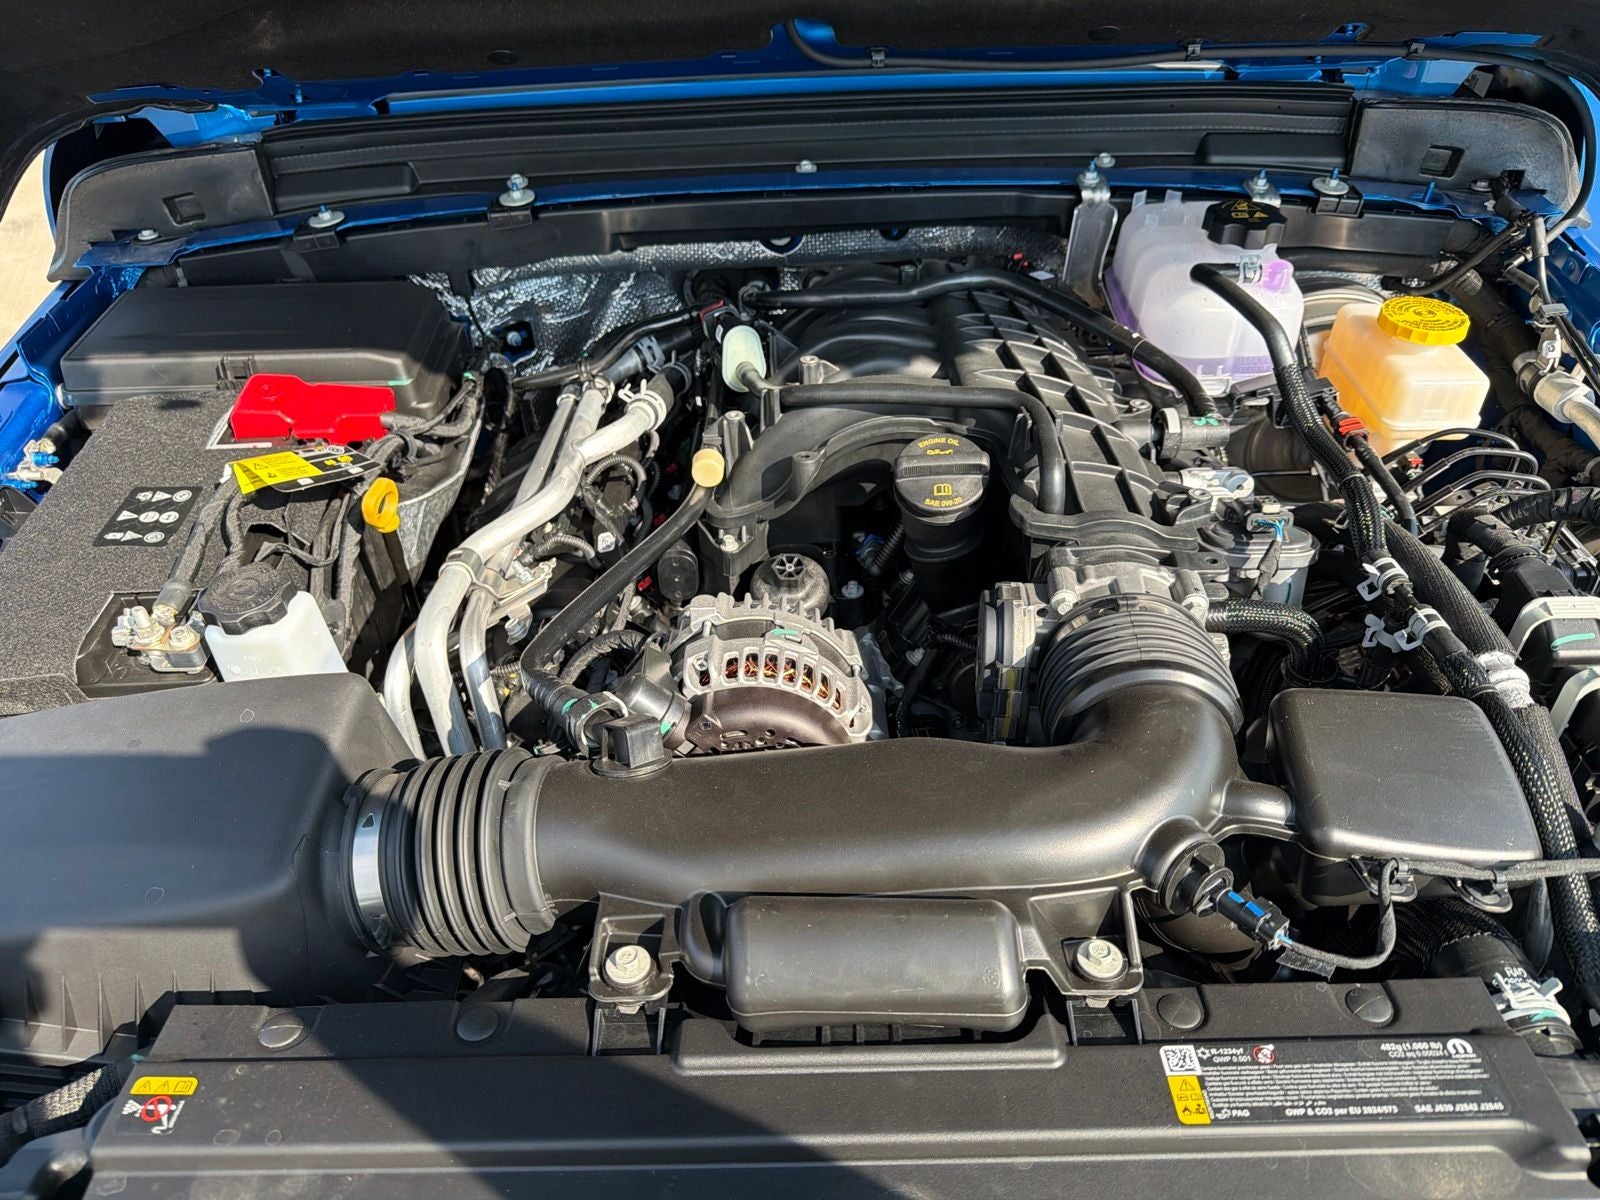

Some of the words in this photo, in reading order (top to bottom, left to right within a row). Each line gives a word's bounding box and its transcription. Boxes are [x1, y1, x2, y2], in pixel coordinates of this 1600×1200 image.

[918, 437, 946, 448] ENGINE
[947, 438, 960, 446] OIL
[924, 498, 940, 507] SAE
[1212, 1055, 1231, 1063] GWP
[1231, 1108, 1250, 1117] PAG
[1285, 1108, 1306, 1116] GWP
[1349, 1106, 1361, 1115] EU
